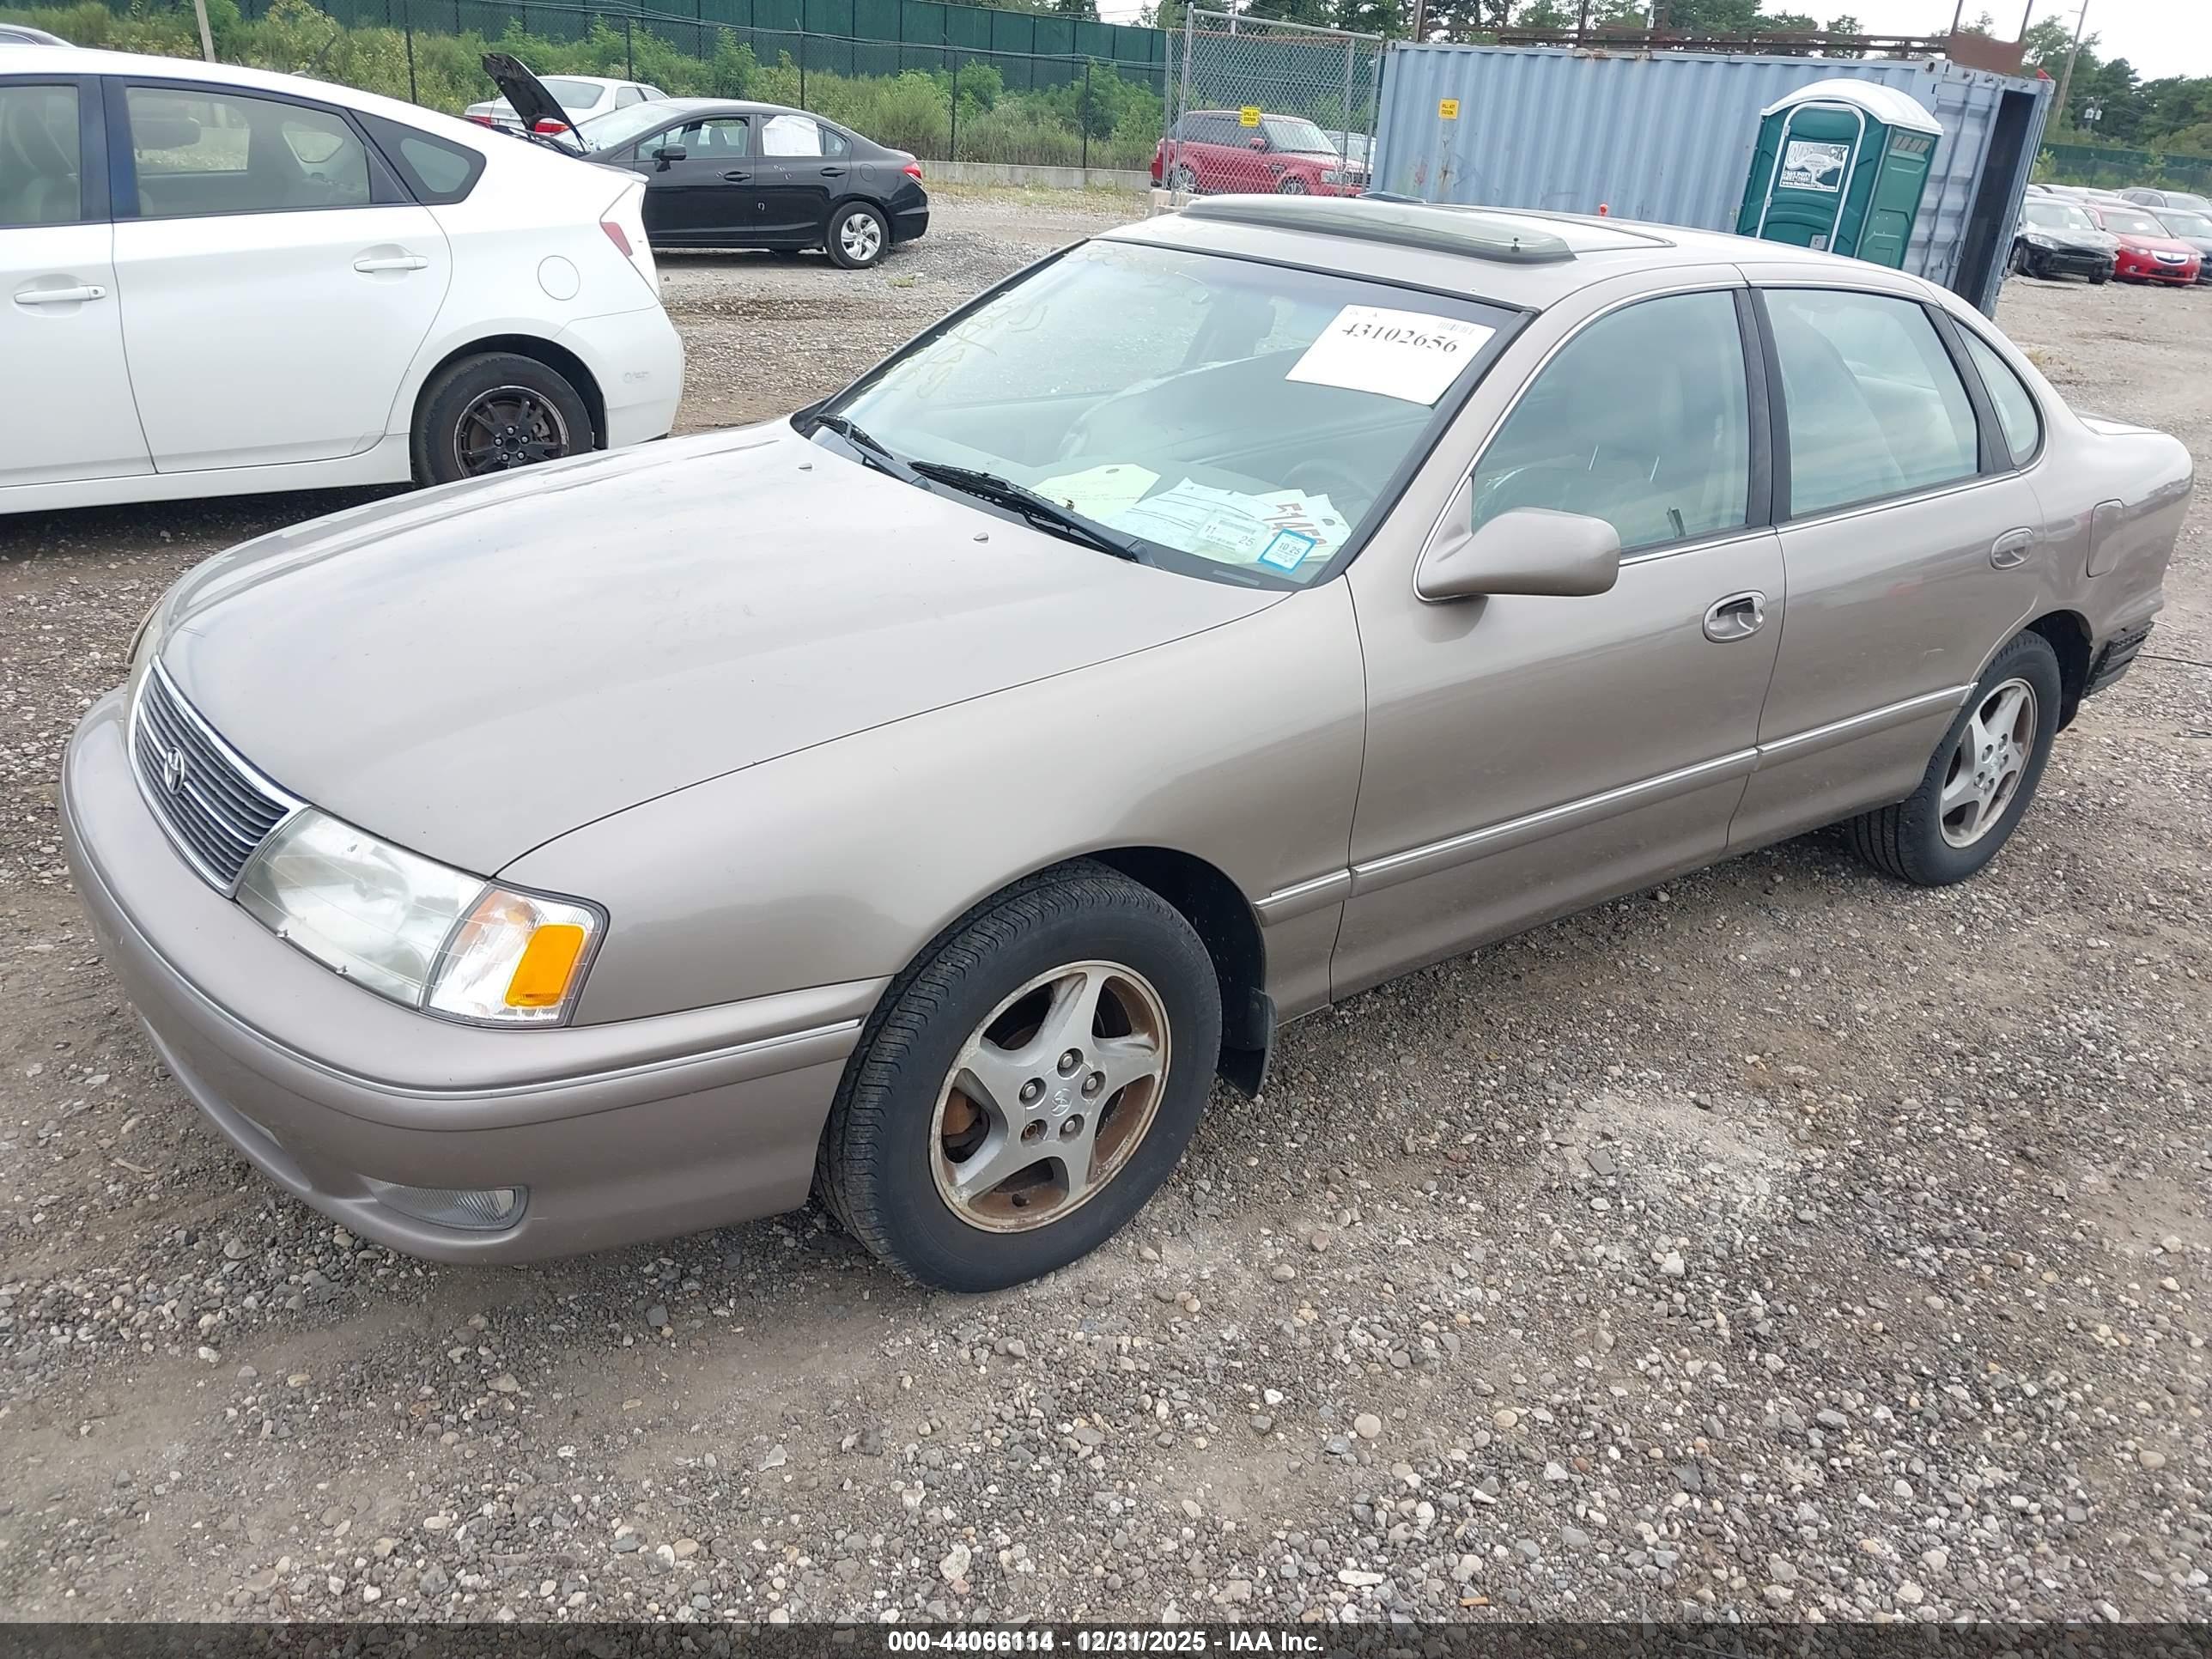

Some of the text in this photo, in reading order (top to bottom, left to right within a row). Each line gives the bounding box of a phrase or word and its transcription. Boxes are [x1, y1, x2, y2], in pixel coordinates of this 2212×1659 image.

[1341, 322, 1459, 354] 43102656
[1237, 536, 1256, 547] 25
[1289, 545, 1303, 556] 25
